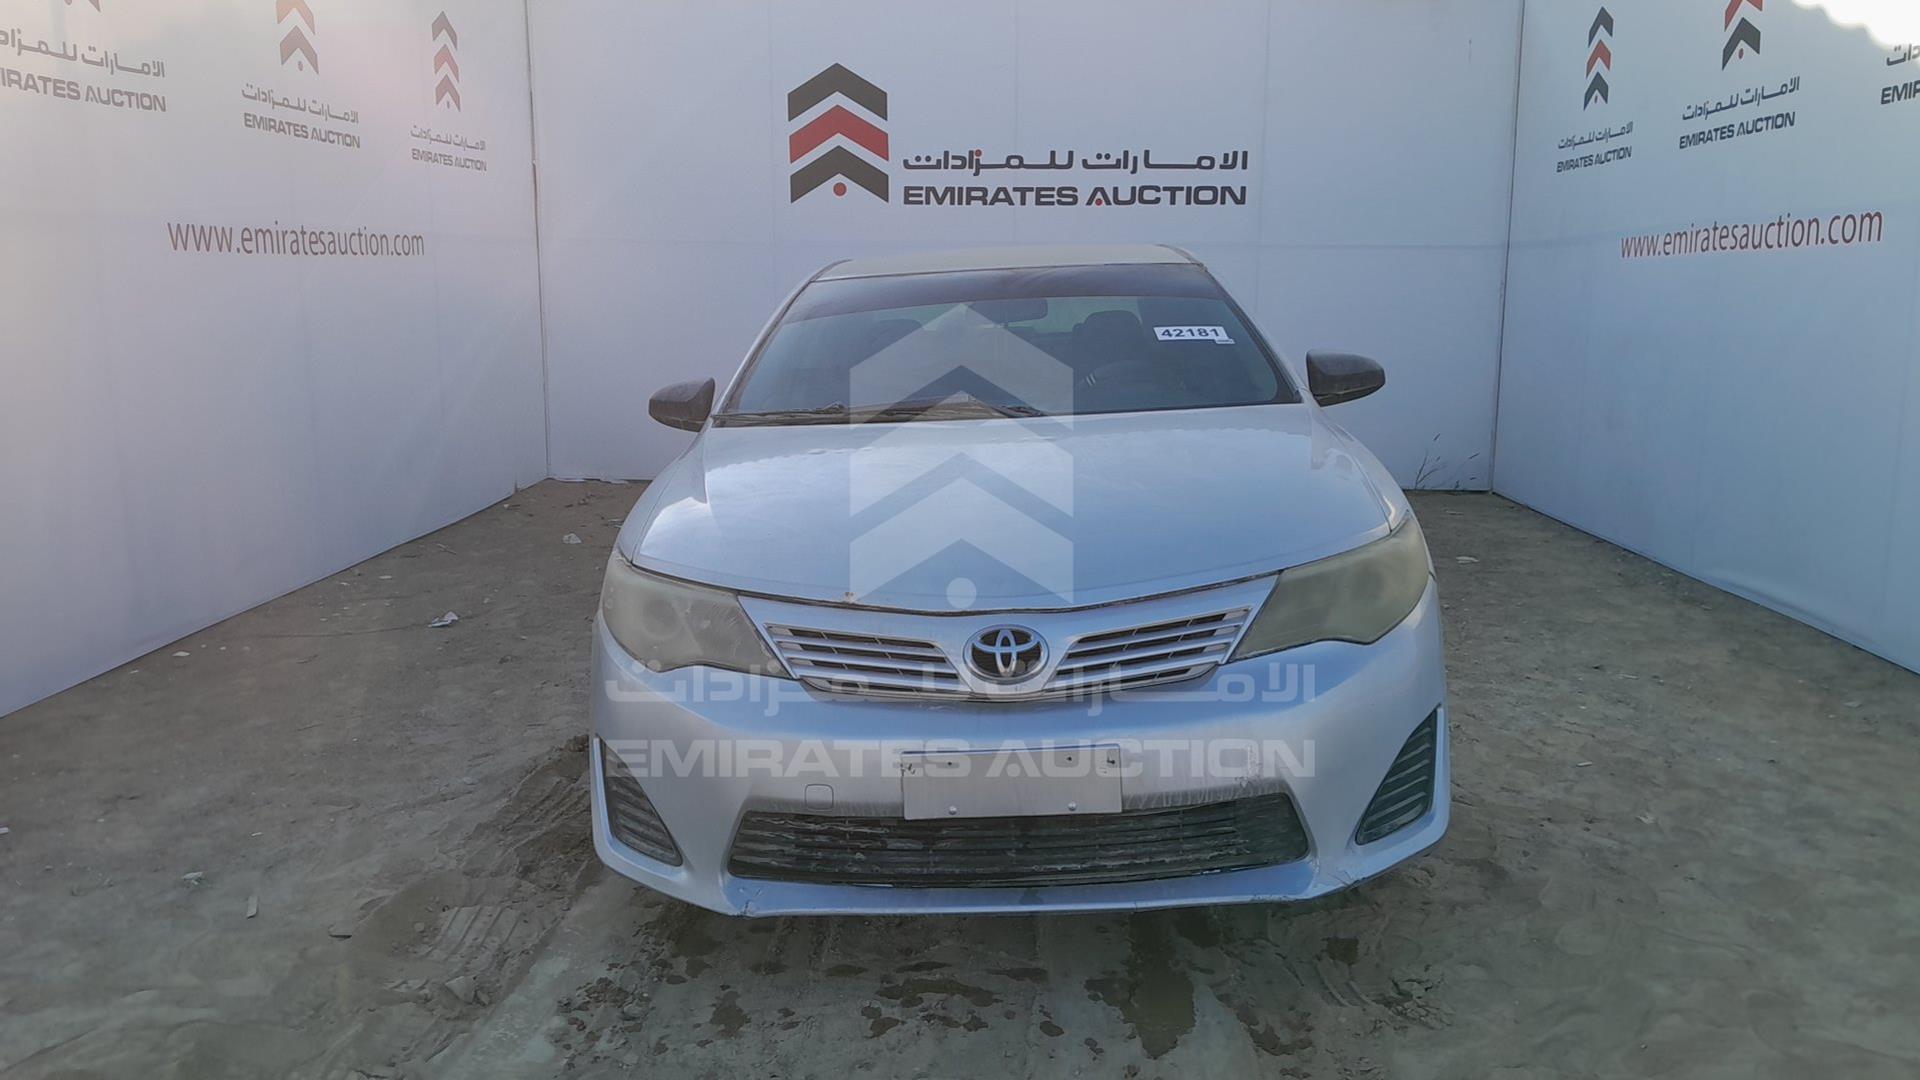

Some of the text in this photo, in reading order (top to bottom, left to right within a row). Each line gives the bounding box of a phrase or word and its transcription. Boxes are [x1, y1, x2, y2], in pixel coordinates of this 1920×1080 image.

[0, 27, 78, 62] للمزاد
[0, 67, 167, 113] IRATES AUCTION
[1880, 79, 1920, 105] EMIR
[243, 112, 361, 149] EMIRATES AUCTION
[1679, 111, 1796, 149] EMIRATES AUCTION
[411, 147, 454, 167] EMIRATES
[903, 149, 1249, 177] الامارات للمزادات
[1556, 154, 1594, 173] EMIRATES
[903, 185, 1247, 206] EMIRATES AUCTION
[1620, 211, 1884, 258] www.emiratesauction.com
[1161, 328, 1220, 338] 42181
